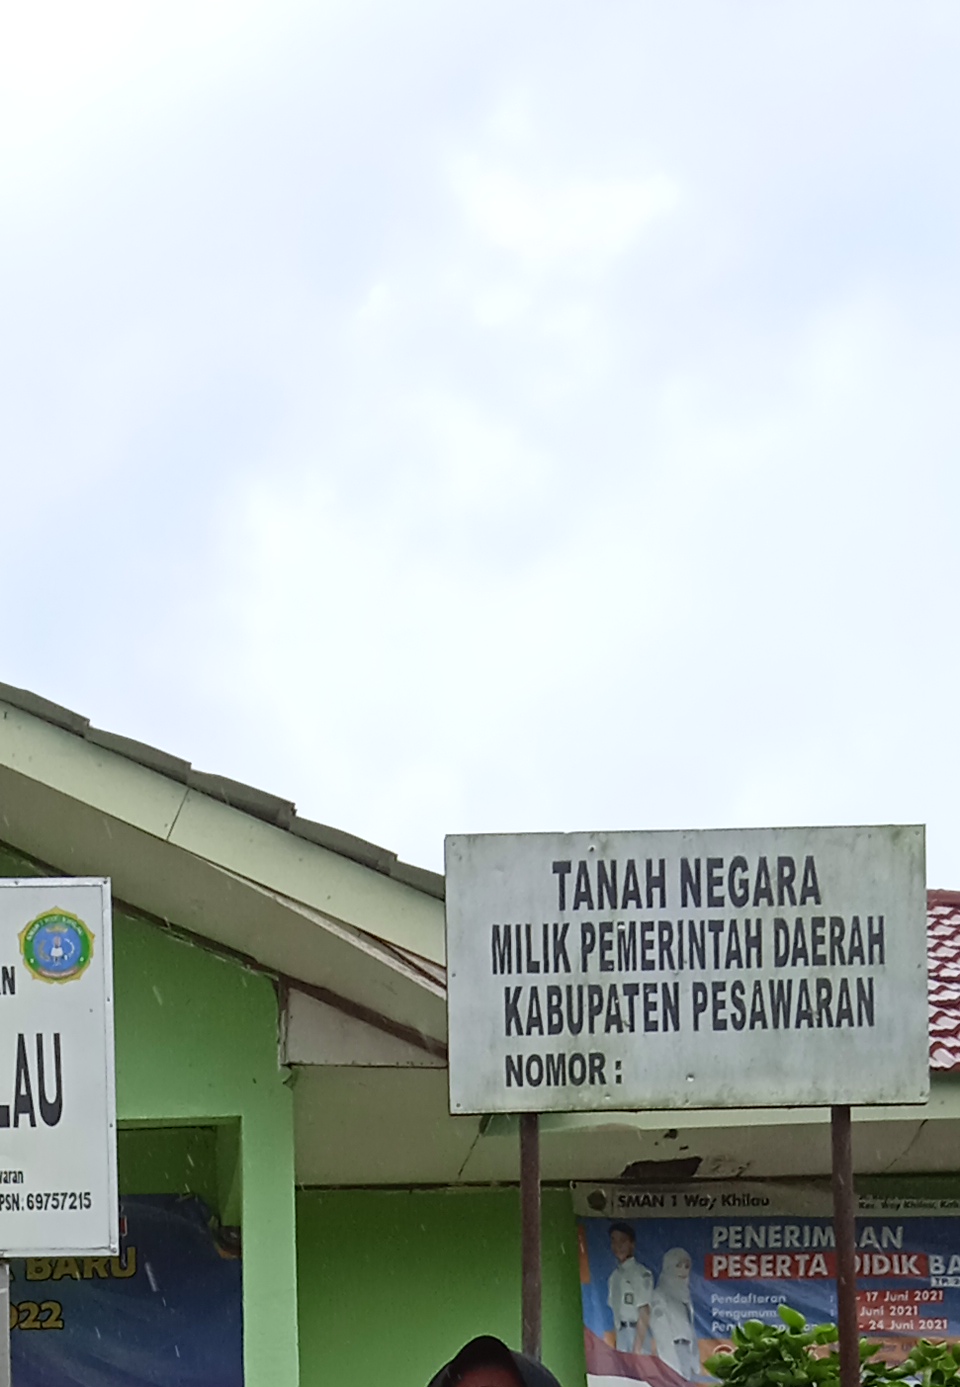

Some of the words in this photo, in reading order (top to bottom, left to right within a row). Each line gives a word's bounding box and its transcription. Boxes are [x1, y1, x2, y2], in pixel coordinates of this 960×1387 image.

[552, 858, 668, 912] TANAH
[680, 855, 821, 908] NEGARA
[492, 922, 570, 974] MILIK
[581, 918, 762, 973] PEMERINTAH
[773, 915, 885, 968] DAERAH
[504, 981, 680, 1037] KABUPATEN
[692, 977, 875, 1031] PESAWARAN
[505, 1052, 607, 1087] NOMOR
[617, 1194, 665, 1209] SMAN
[671, 1195, 677, 1207] 1
[683, 1194, 715, 1211] Way
[721, 1194, 770, 1207] Khilau
[711, 1225, 903, 1249] PENERIMAN
[25, 1247, 137, 1281] BARU
[711, 1254, 829, 1278] PESERTA
[866, 1292, 878, 1302] 17
[884, 1290, 909, 1302] Juni
[914, 1290, 943, 1301] 2021
[860, 1305, 884, 1317] Juni
[890, 1305, 918, 1316] 2021
[868, 1320, 884, 1330] 24
[890, 1319, 914, 1330] Juni
[919, 1319, 948, 1330] 2021
